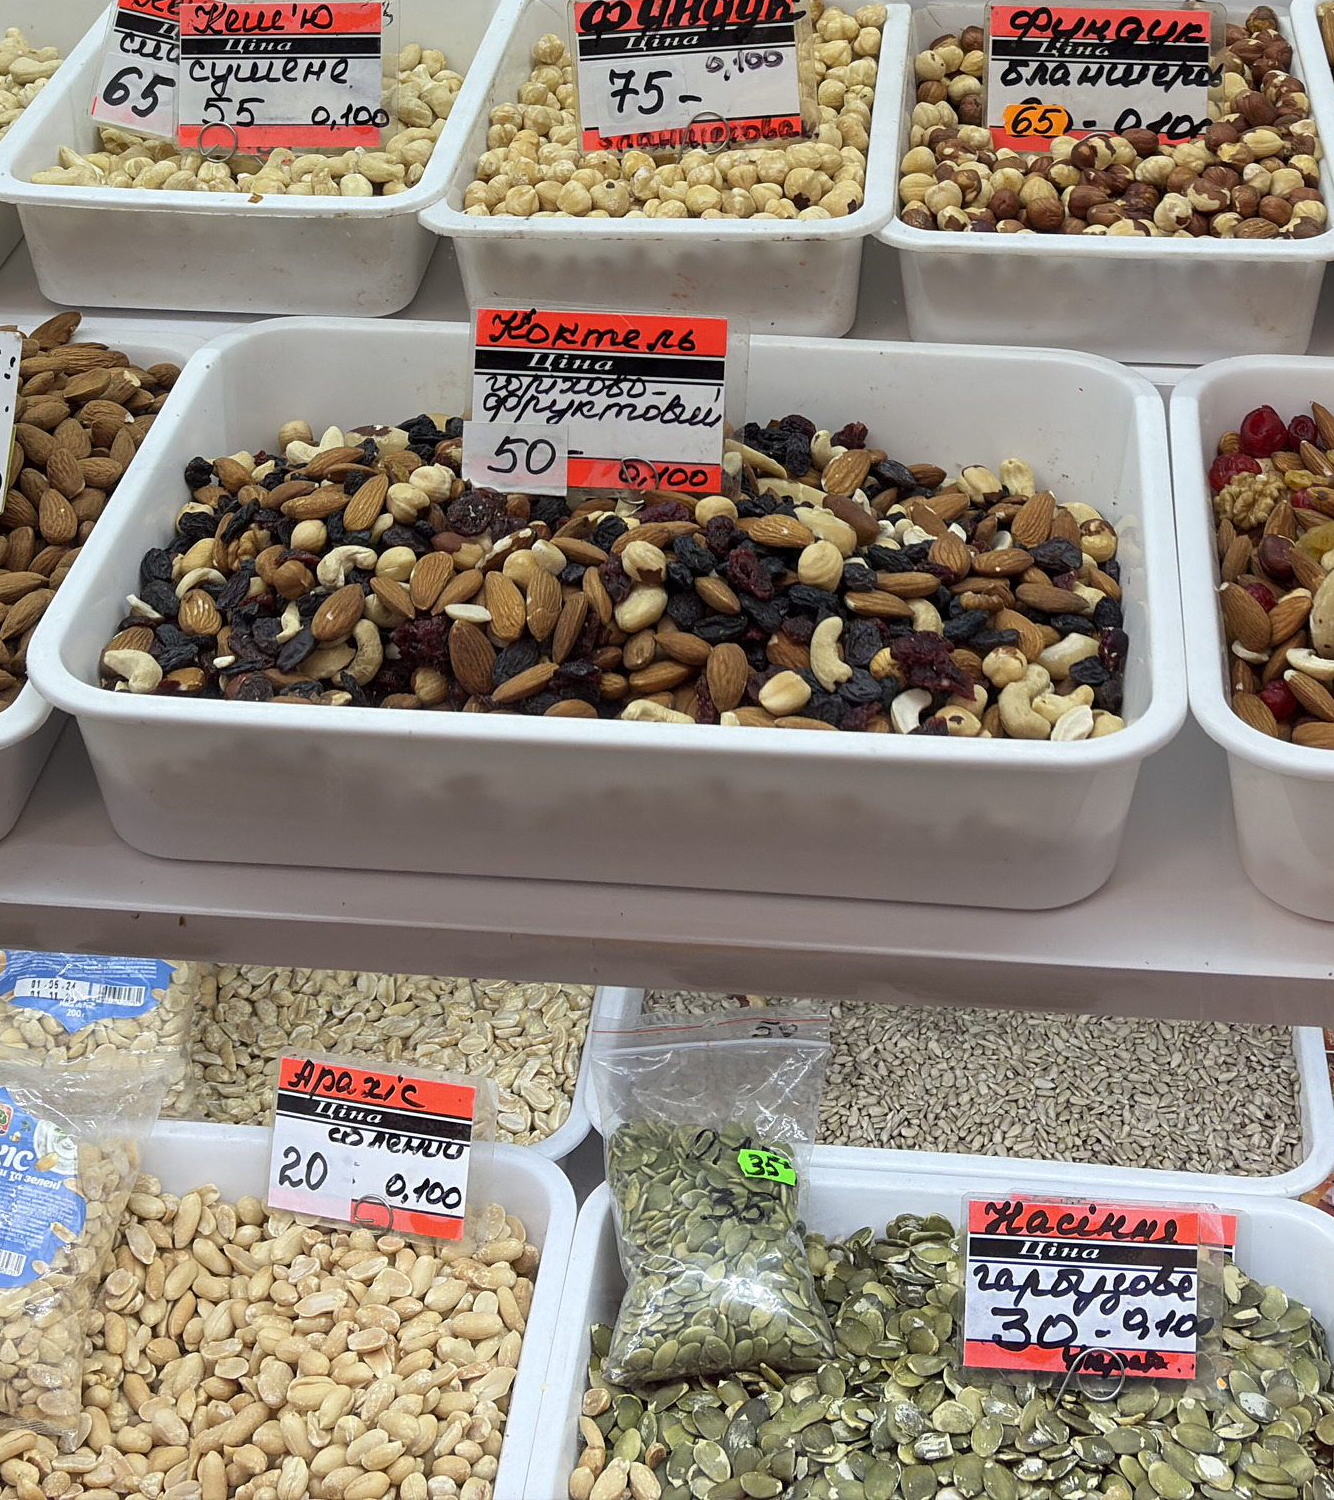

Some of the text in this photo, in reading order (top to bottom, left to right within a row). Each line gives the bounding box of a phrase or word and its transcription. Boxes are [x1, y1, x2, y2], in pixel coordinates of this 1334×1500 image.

[223, 38, 294, 53] Ціна
[624, 35, 700, 51] Ціна
[1036, 42, 1111, 58] Ціна
[101, 66, 177, 118] 65
[189, 58, 350, 98] сушене
[608, 68, 673, 115] 75
[201, 96, 391, 131] 55 0,100
[1010, 105, 1063, 135] 65
[526, 353, 616, 371] Ціна
[486, 434, 557, 475] 50
[66, 1008, 81, 1017] 200
[287, 1058, 426, 1109] Арахіс
[314, 1101, 383, 1124] Ціна
[24, 1175, 62, 1191] зелені
[278, 1145, 463, 1211] 20 0,100
[1017, 1240, 1101, 1260] Ціна
[990, 1306, 1079, 1351] 30
